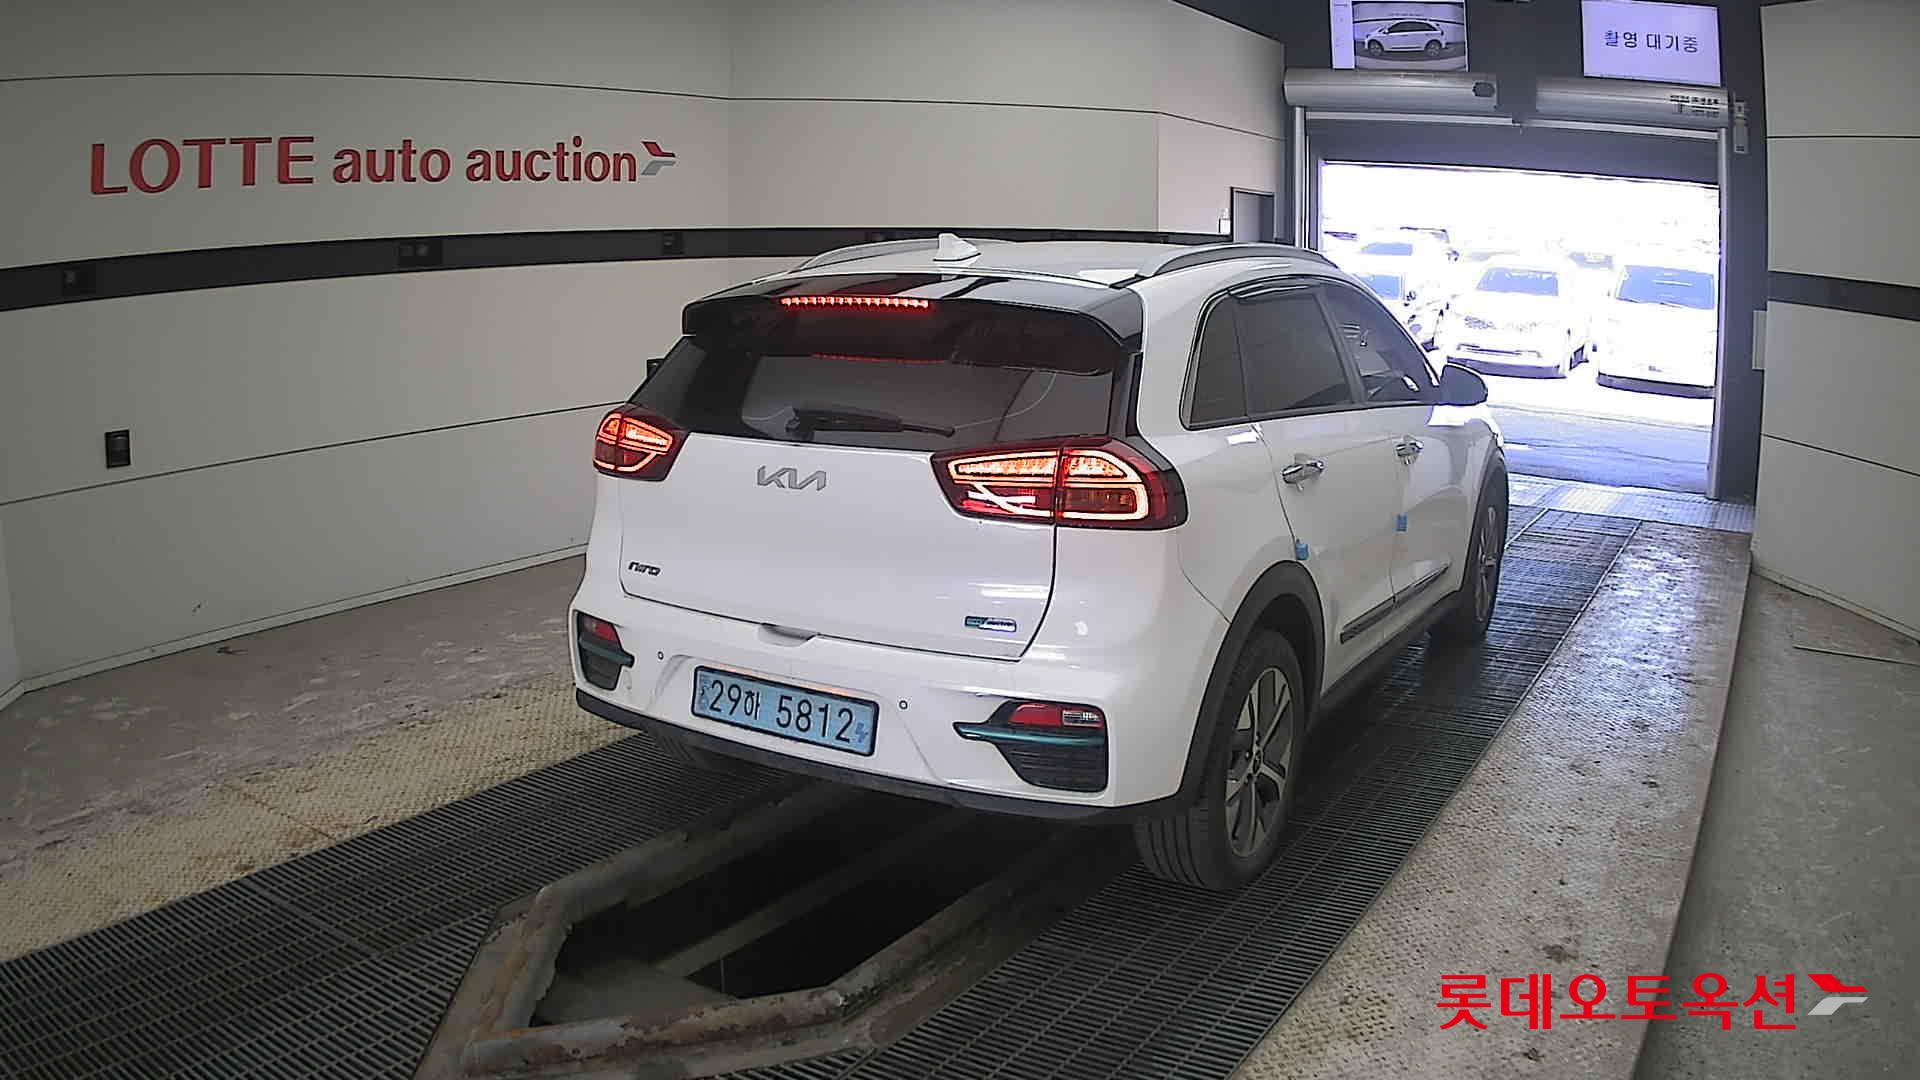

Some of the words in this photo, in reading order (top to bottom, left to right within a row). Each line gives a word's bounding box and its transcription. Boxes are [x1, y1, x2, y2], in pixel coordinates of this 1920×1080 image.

[1646, 33, 1699, 53] 대기중
[91, 136, 314, 195] LOTTE
[332, 139, 451, 183] auto
[465, 135, 637, 182] auction
[757, 465, 827, 491] KIA
[709, 679, 761, 721] 29하
[775, 694, 853, 744] 5812
